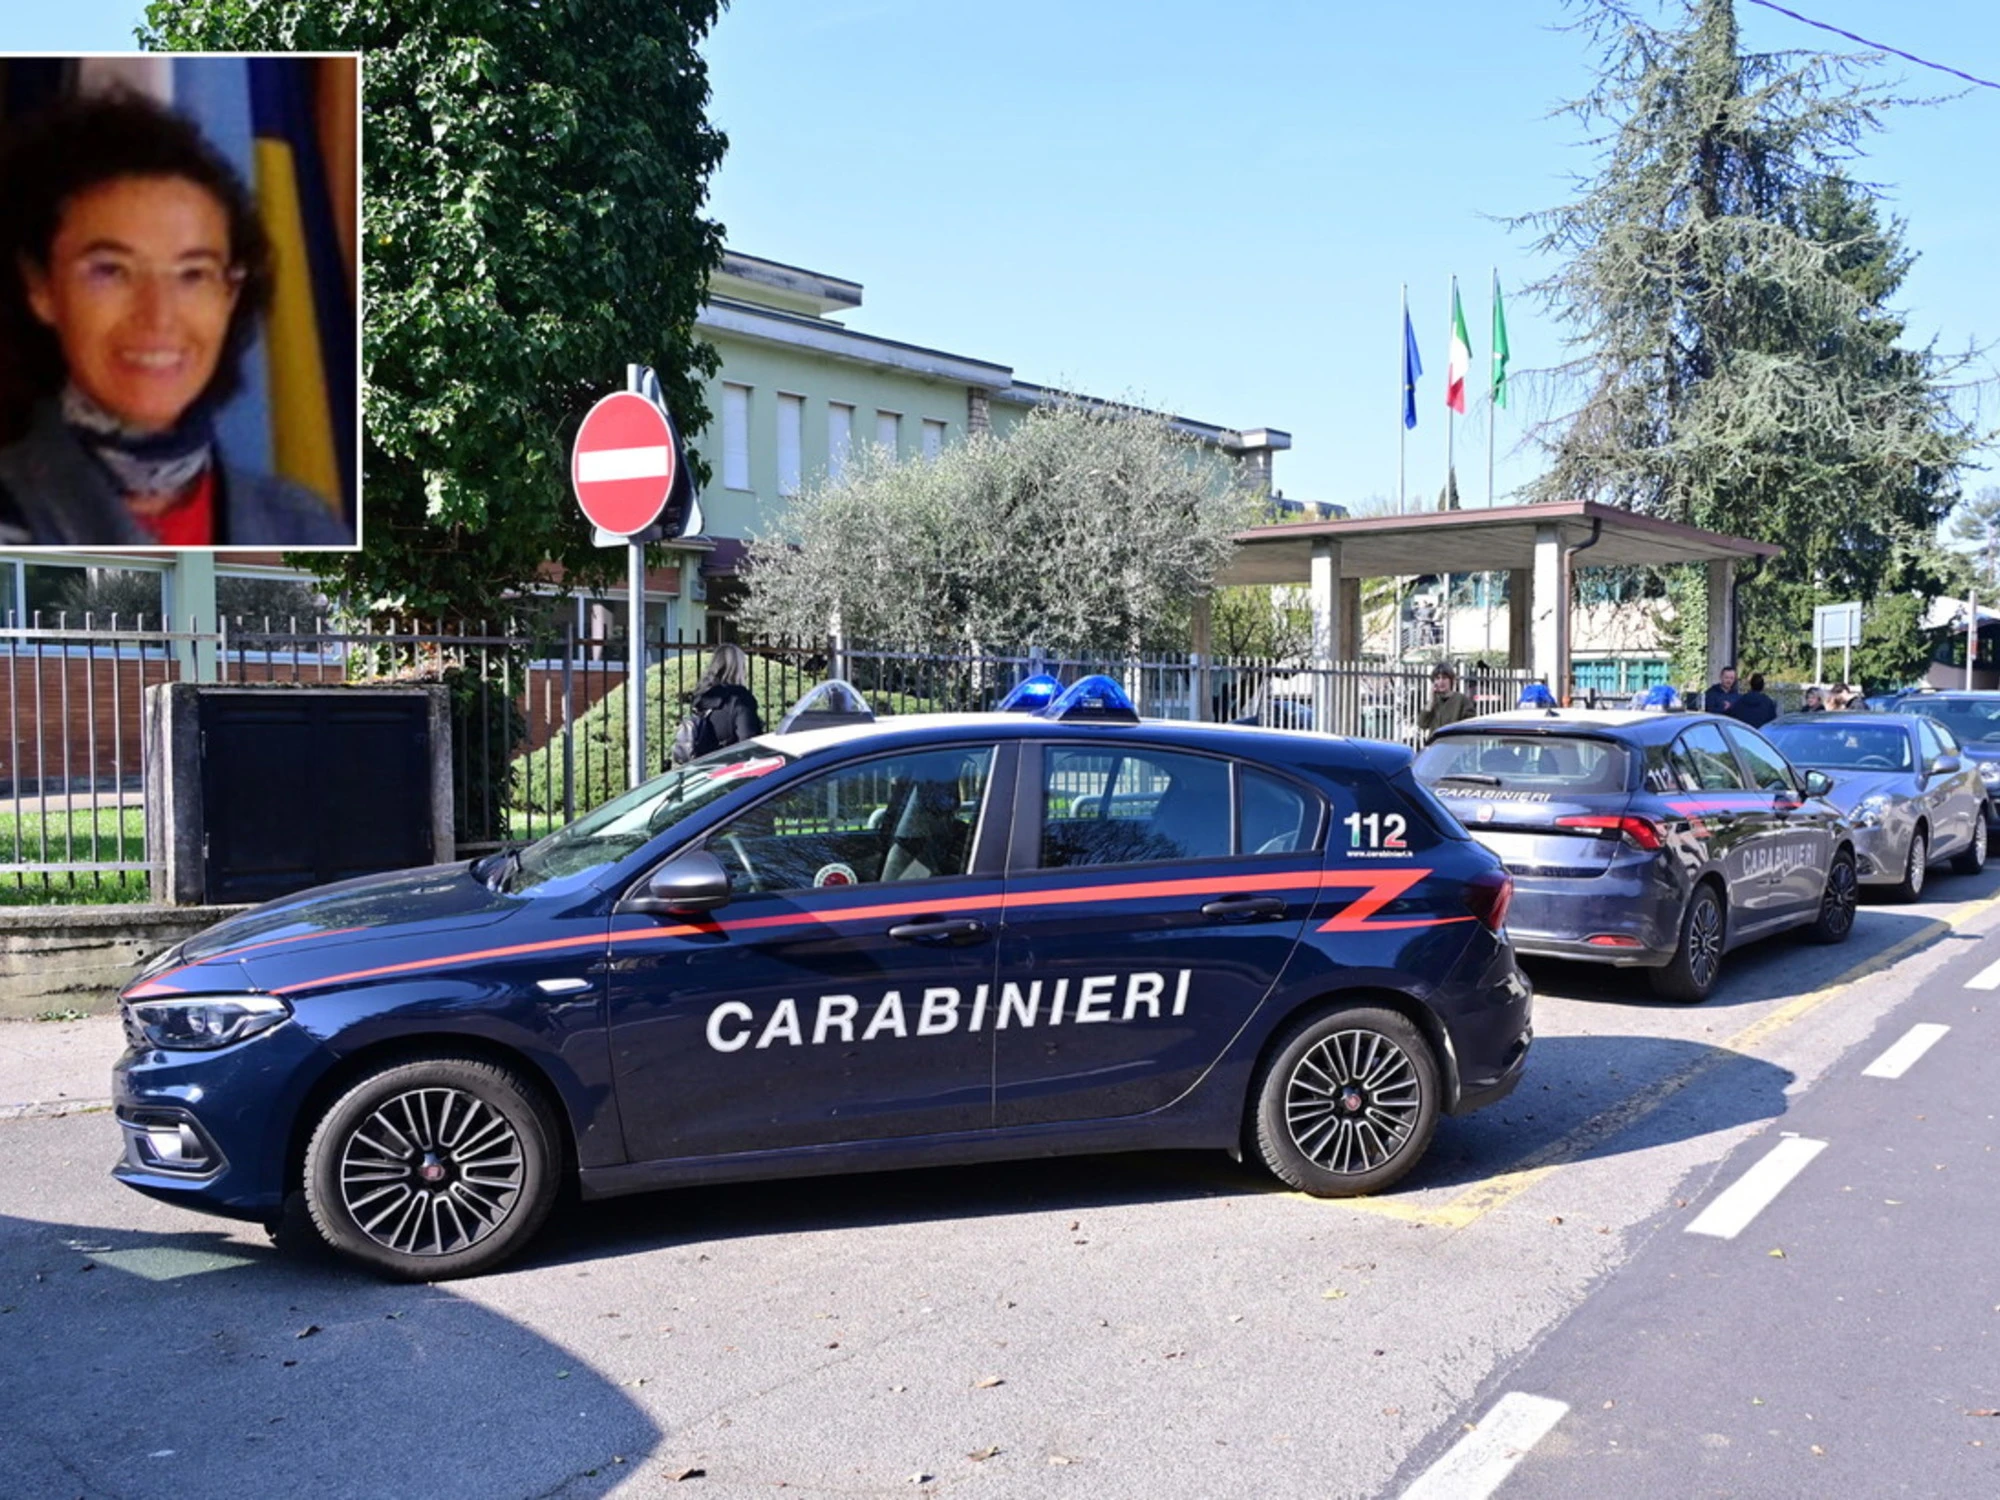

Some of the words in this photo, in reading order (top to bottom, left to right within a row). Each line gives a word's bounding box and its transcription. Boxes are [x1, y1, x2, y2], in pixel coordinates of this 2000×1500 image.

[1434, 787, 1551, 803] CARABINIERI
[1344, 812, 1407, 848] 112
[1743, 843, 1817, 876] CARABINIERI
[706, 969, 1191, 1052] CARABINIERI
